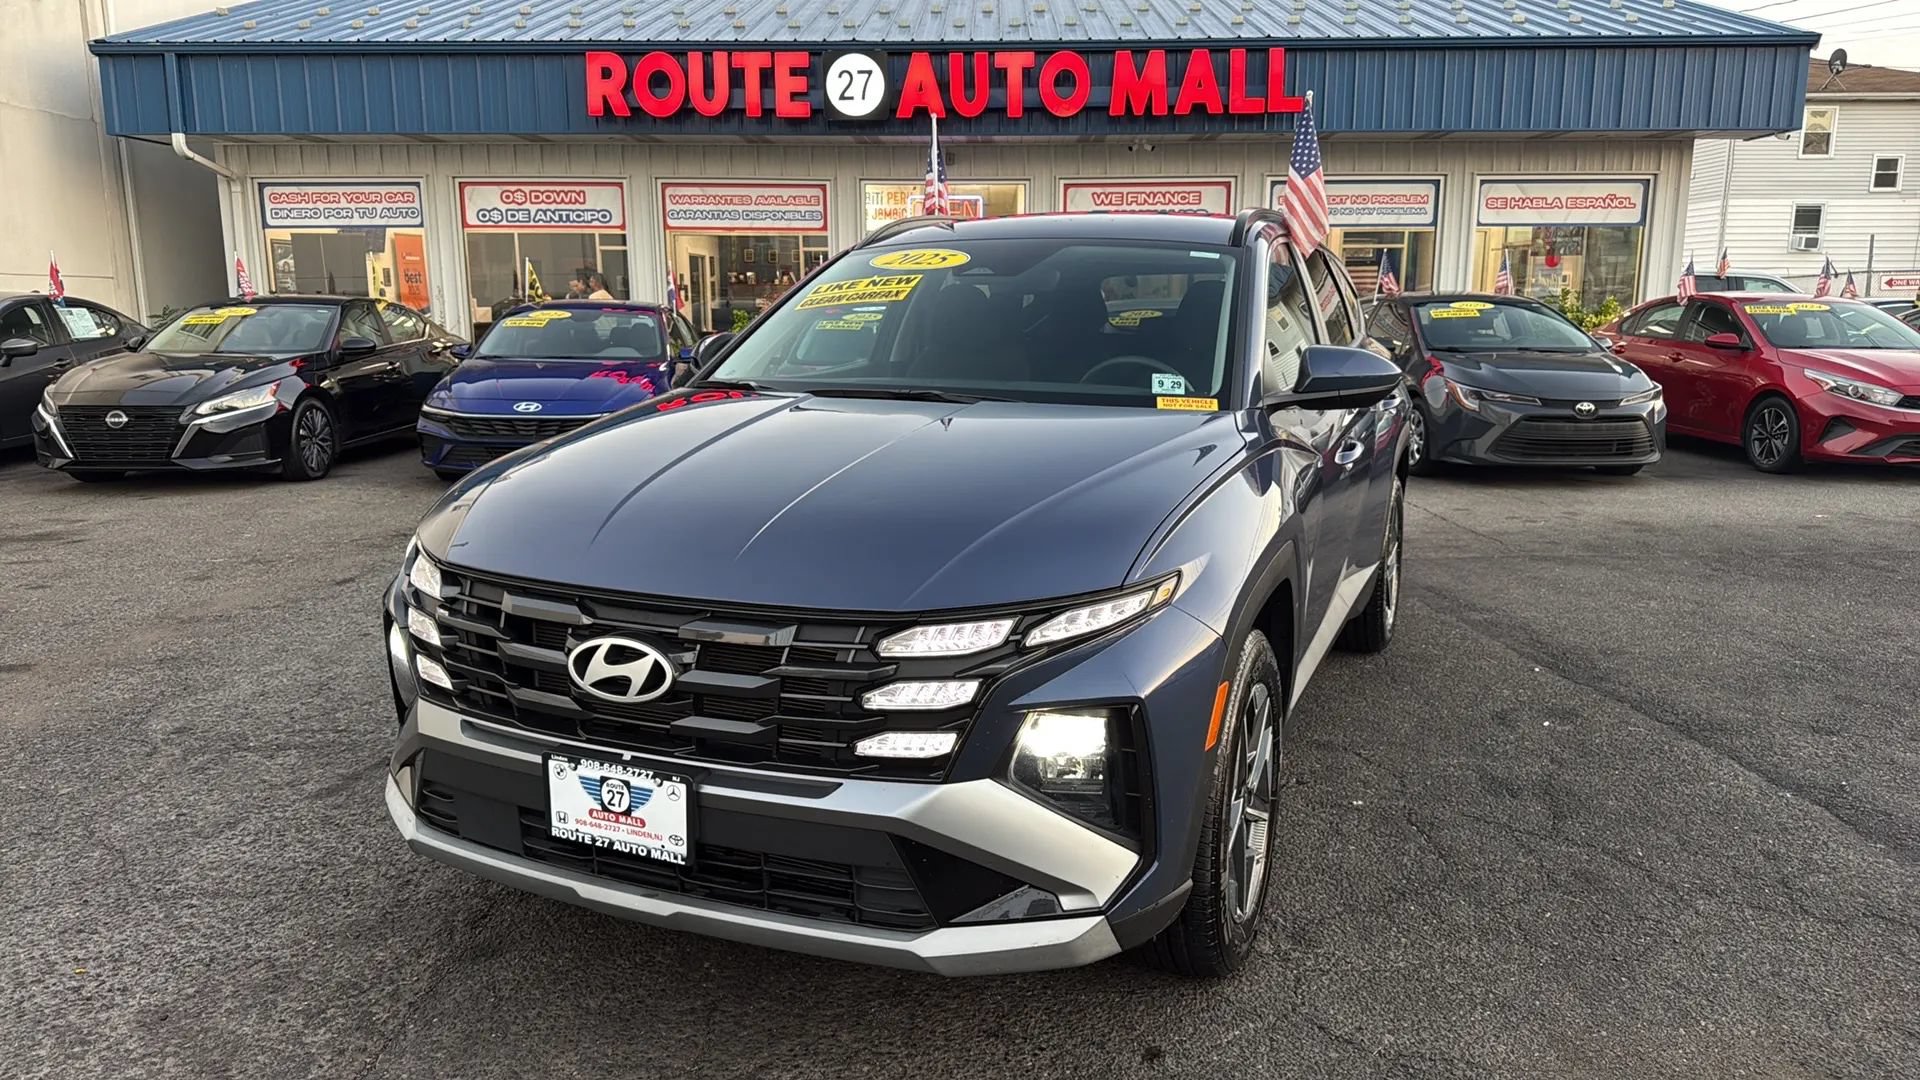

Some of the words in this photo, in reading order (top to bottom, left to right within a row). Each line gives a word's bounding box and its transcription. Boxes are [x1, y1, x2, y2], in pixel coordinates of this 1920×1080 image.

[586, 50, 810, 118] ROUTE
[837, 69, 874, 101] 27
[896, 49, 1090, 118] AUTO
[1108, 47, 1304, 117] MALL
[269, 192, 309, 204] CASH
[312, 192, 340, 204] FOR
[342, 192, 382, 204] YOUR
[384, 192, 416, 204] CAR
[529, 190, 586, 204] DOWN
[670, 194, 752, 205] WARRANTIES
[754, 195, 820, 206] AVAILABLE
[1092, 192, 1123, 206] WE
[1125, 191, 1201, 205] FINANCE
[1351, 194, 1369, 205] NO
[1372, 194, 1429, 205] PROBLEM
[1486, 197, 1508, 209] SE
[1510, 197, 1563, 209] HABLA
[1566, 194, 1636, 209] ESPAÑOL
[271, 207, 321, 219] DINERO
[323, 207, 353, 219] POR
[356, 207, 377, 219] TU
[379, 207, 419, 219] AUTO
[506, 209, 530, 223] DE
[533, 209, 612, 223] ANTICIPO
[668, 210, 740, 220] GARANTIAS
[742, 210, 823, 221] DISPONIBLES
[1340, 207, 1355, 215] NO
[1356, 207, 1375, 215] HAY
[1376, 207, 1428, 215] PROBLEMA
[884, 253, 958, 265] 2025
[813, 280, 860, 295] LIKE
[865, 276, 918, 288] NEW
[800, 295, 847, 308] CLEAN
[846, 289, 903, 302] CARFAX
[1158, 380, 1165, 388] 9
[1170, 380, 1182, 389] 29
[580, 759, 654, 780] 908-648-2727
[606, 782, 624, 791] ROUTE
[606, 789, 625, 808] 27
[574, 818, 620, 833] 908-648-2727
[592, 810, 616, 822] AUTO
[619, 815, 643, 828] MALL
[551, 826, 592, 844] ROUTE
[595, 834, 610, 848] 27
[613, 840, 648, 857] AUTO
[651, 849, 686, 865] MALL
